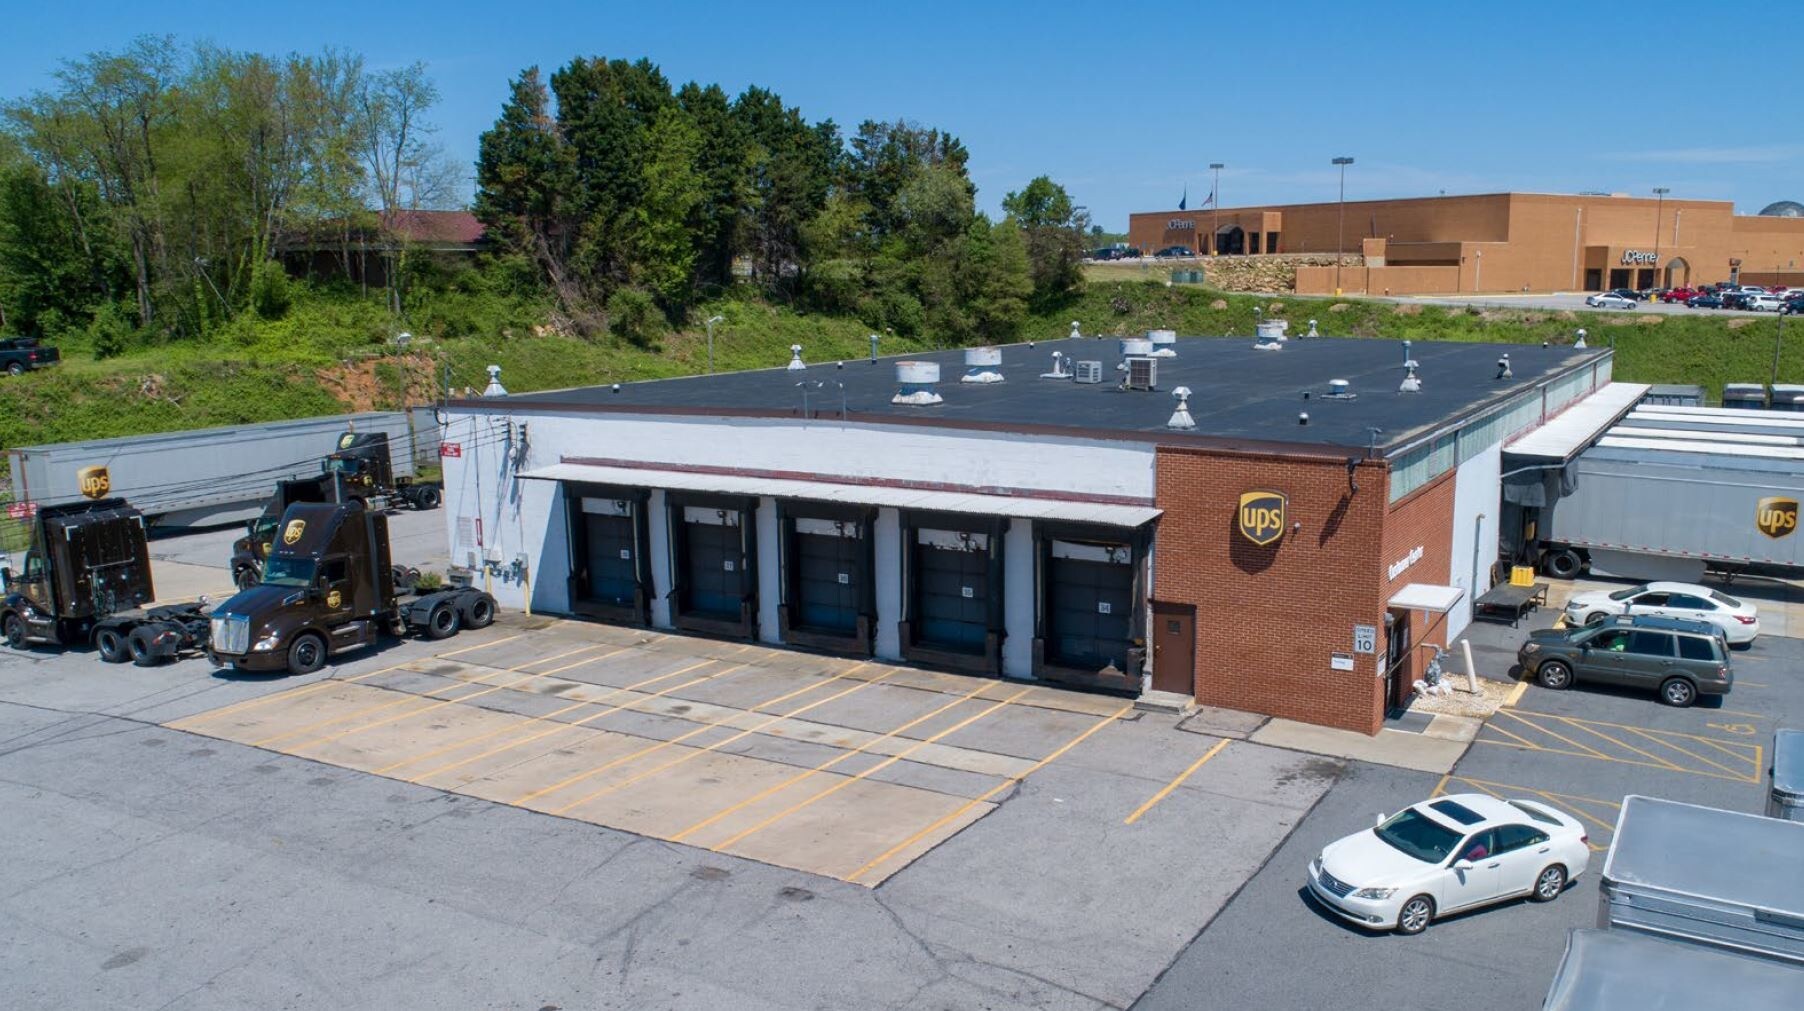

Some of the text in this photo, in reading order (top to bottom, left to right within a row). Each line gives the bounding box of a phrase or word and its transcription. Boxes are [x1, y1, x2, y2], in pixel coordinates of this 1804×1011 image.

[1243, 507, 1281, 536] ups
[1759, 509, 1796, 534] ups
[1357, 640, 1373, 651] 10
